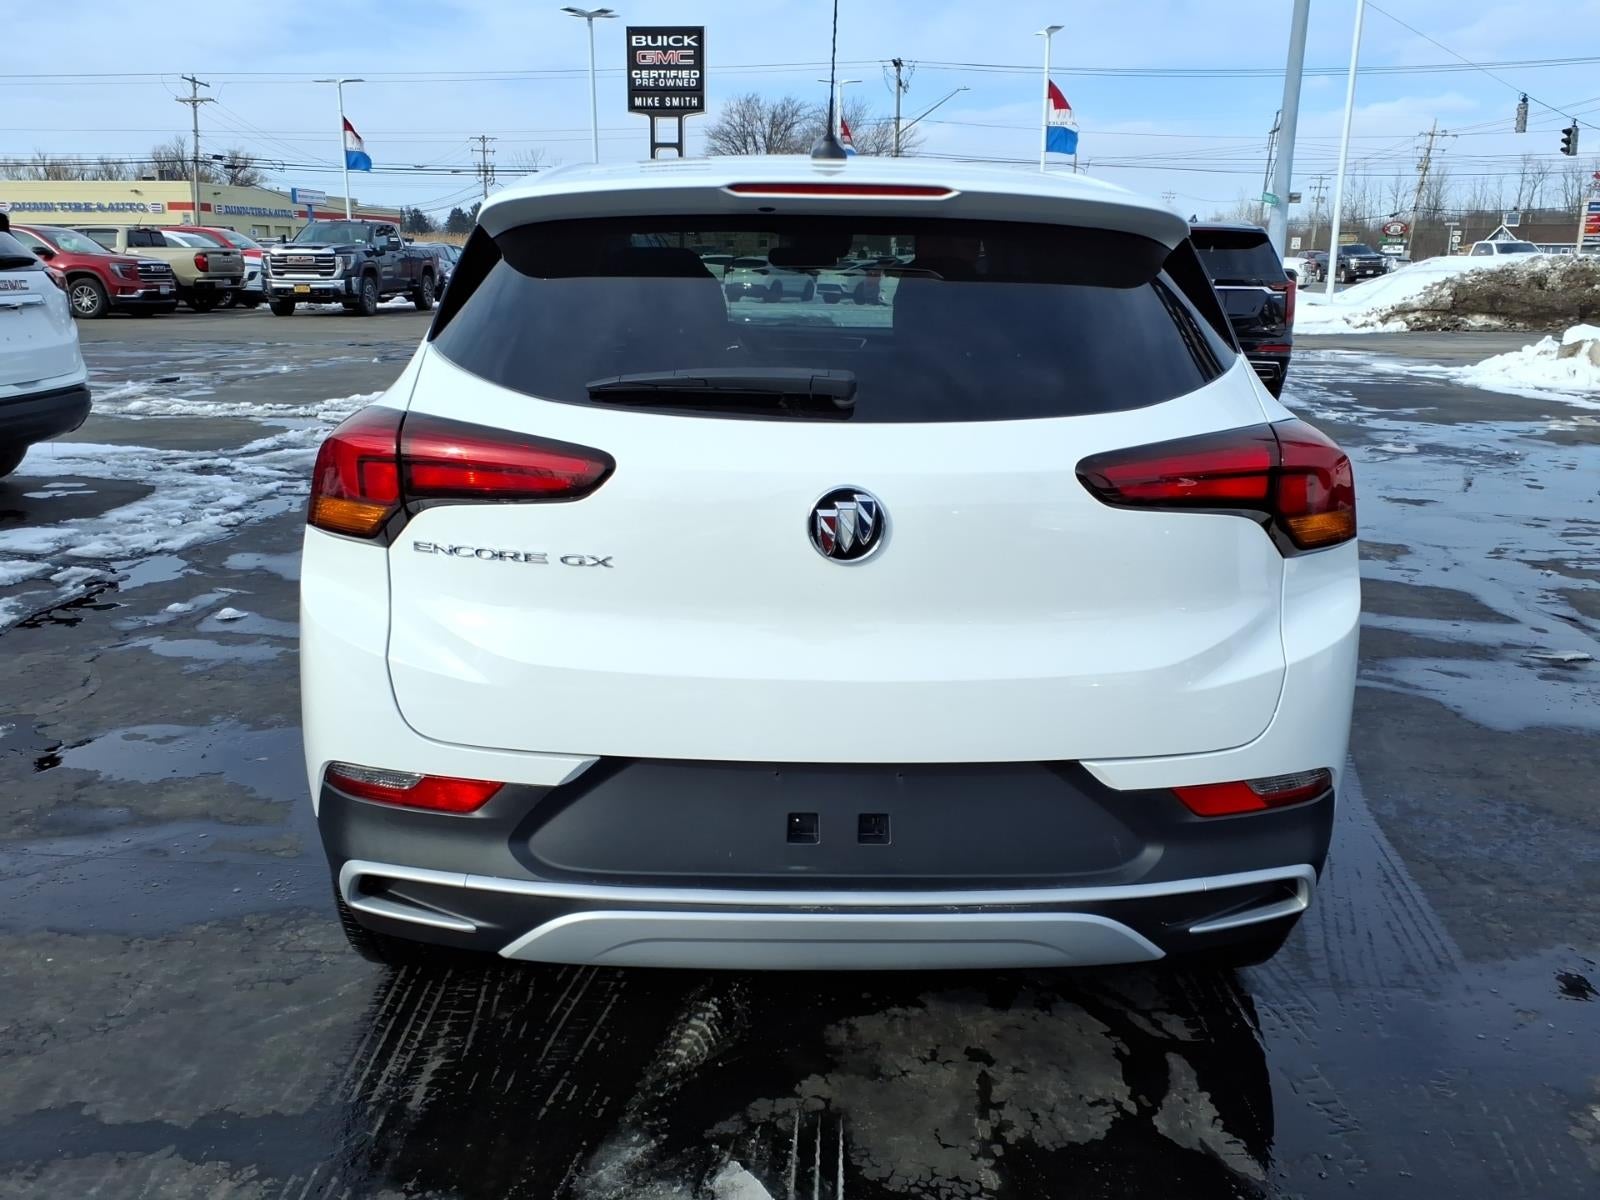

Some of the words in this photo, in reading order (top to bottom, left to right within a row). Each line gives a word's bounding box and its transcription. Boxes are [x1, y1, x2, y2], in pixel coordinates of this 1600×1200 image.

[631, 35, 699, 47] BUICK
[636, 50, 695, 65] GMC
[631, 70, 700, 78] CERTIFIED
[635, 79, 697, 87] PRE-OWNED
[634, 97, 660, 107] MIKE
[665, 97, 698, 107] SMITH
[11, 202, 55, 213] DUNN
[57, 202, 92, 213] TIRE
[107, 203, 148, 213] AUTO
[413, 540, 549, 565] ENCORE
[560, 554, 614, 568] GX
